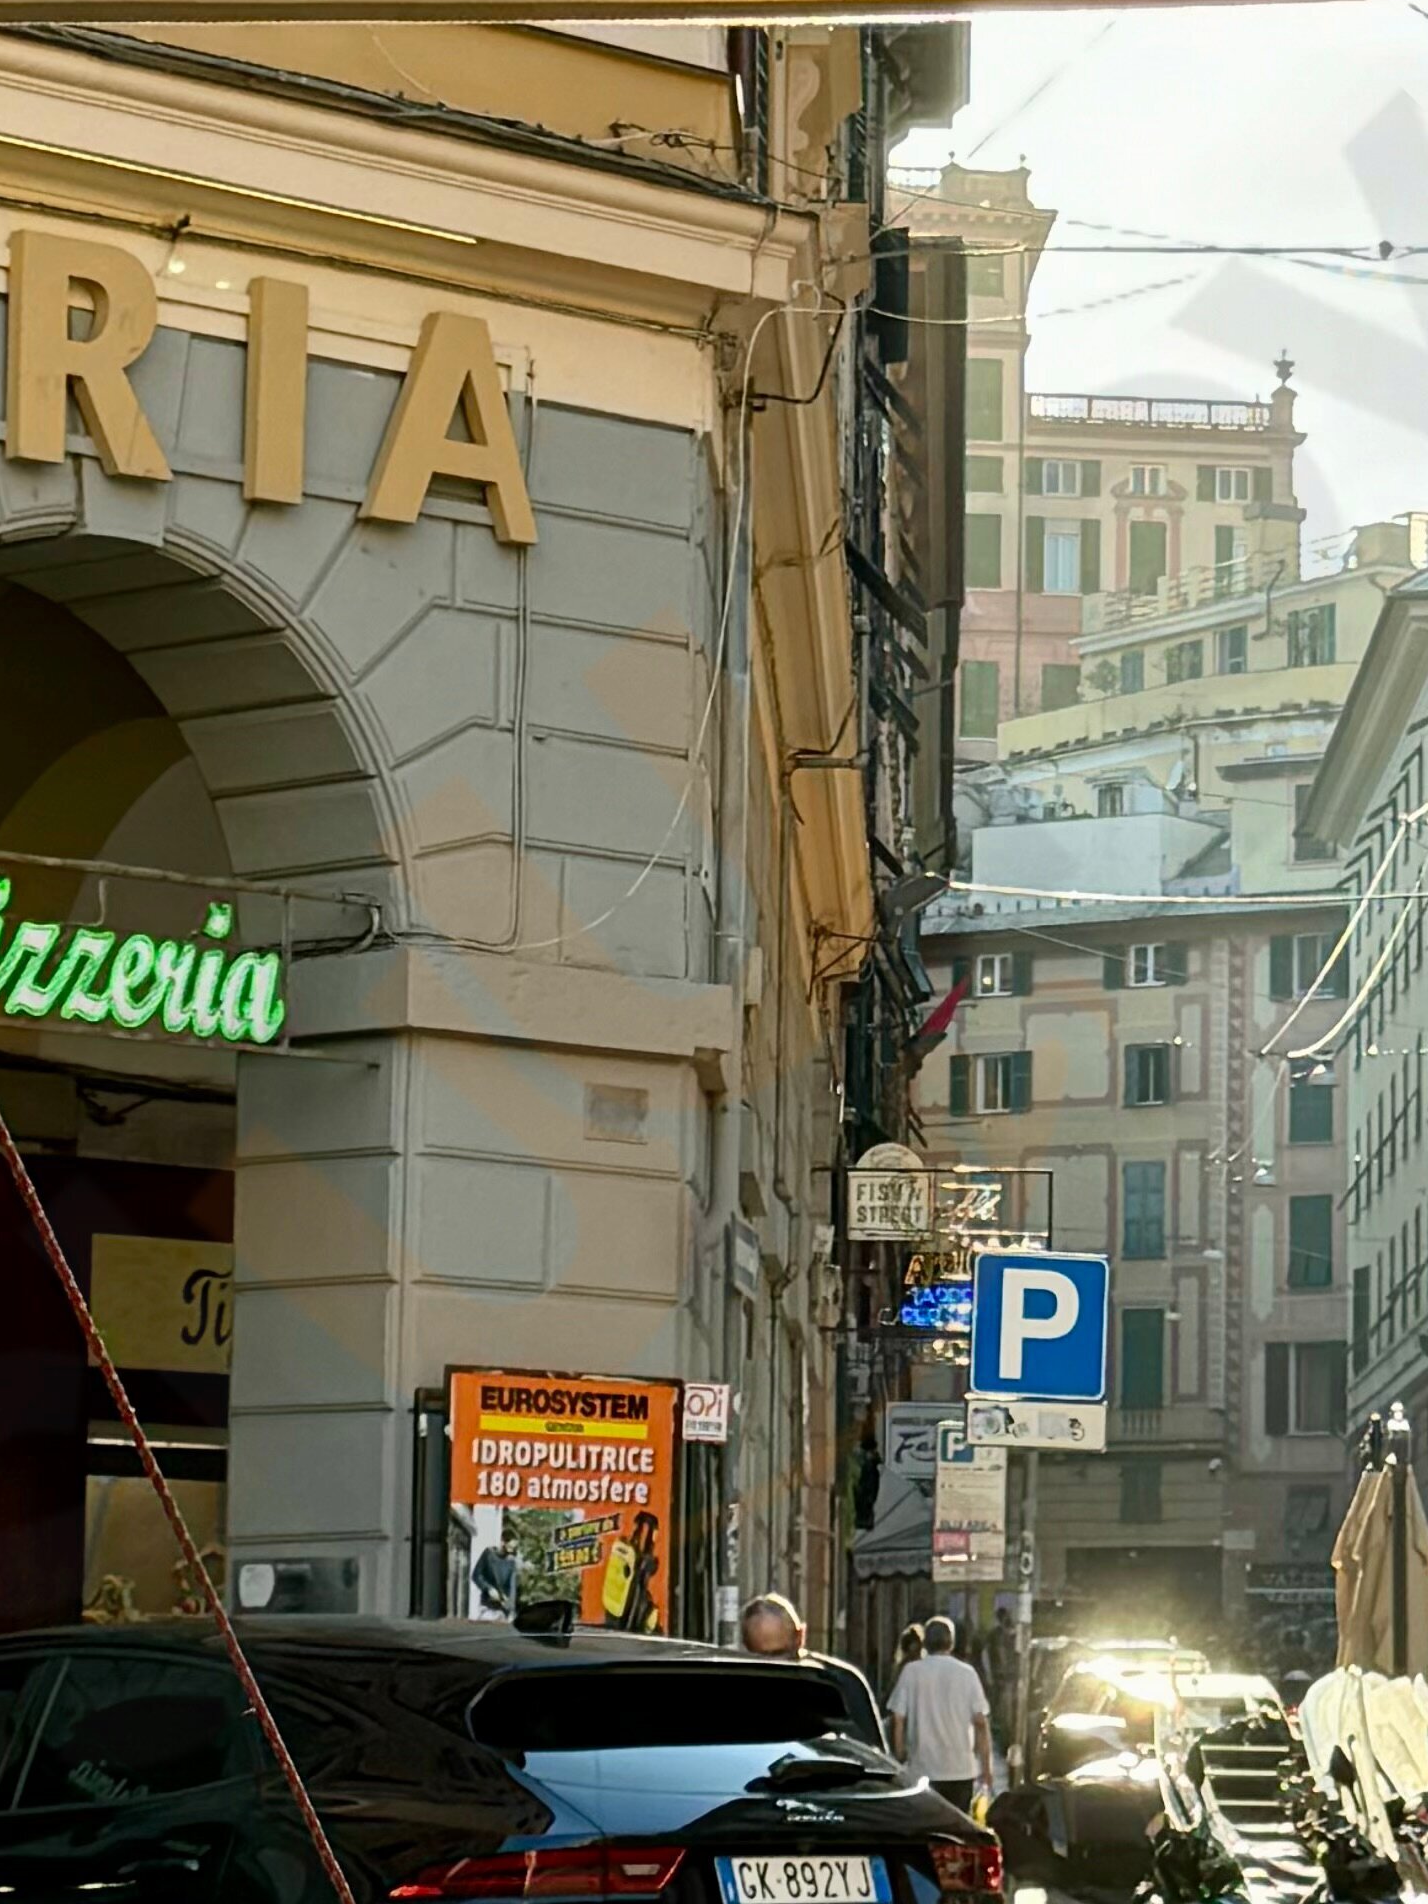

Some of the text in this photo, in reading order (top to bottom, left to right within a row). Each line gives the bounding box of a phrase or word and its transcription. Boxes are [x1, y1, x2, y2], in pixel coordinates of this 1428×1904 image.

[999, 1268, 1079, 1379] P
[480, 1386, 649, 1420] EUROSYSTEM
[472, 1438, 654, 1473] IDROPULITRICE
[477, 1473, 648, 1504] 180 atmosfere
